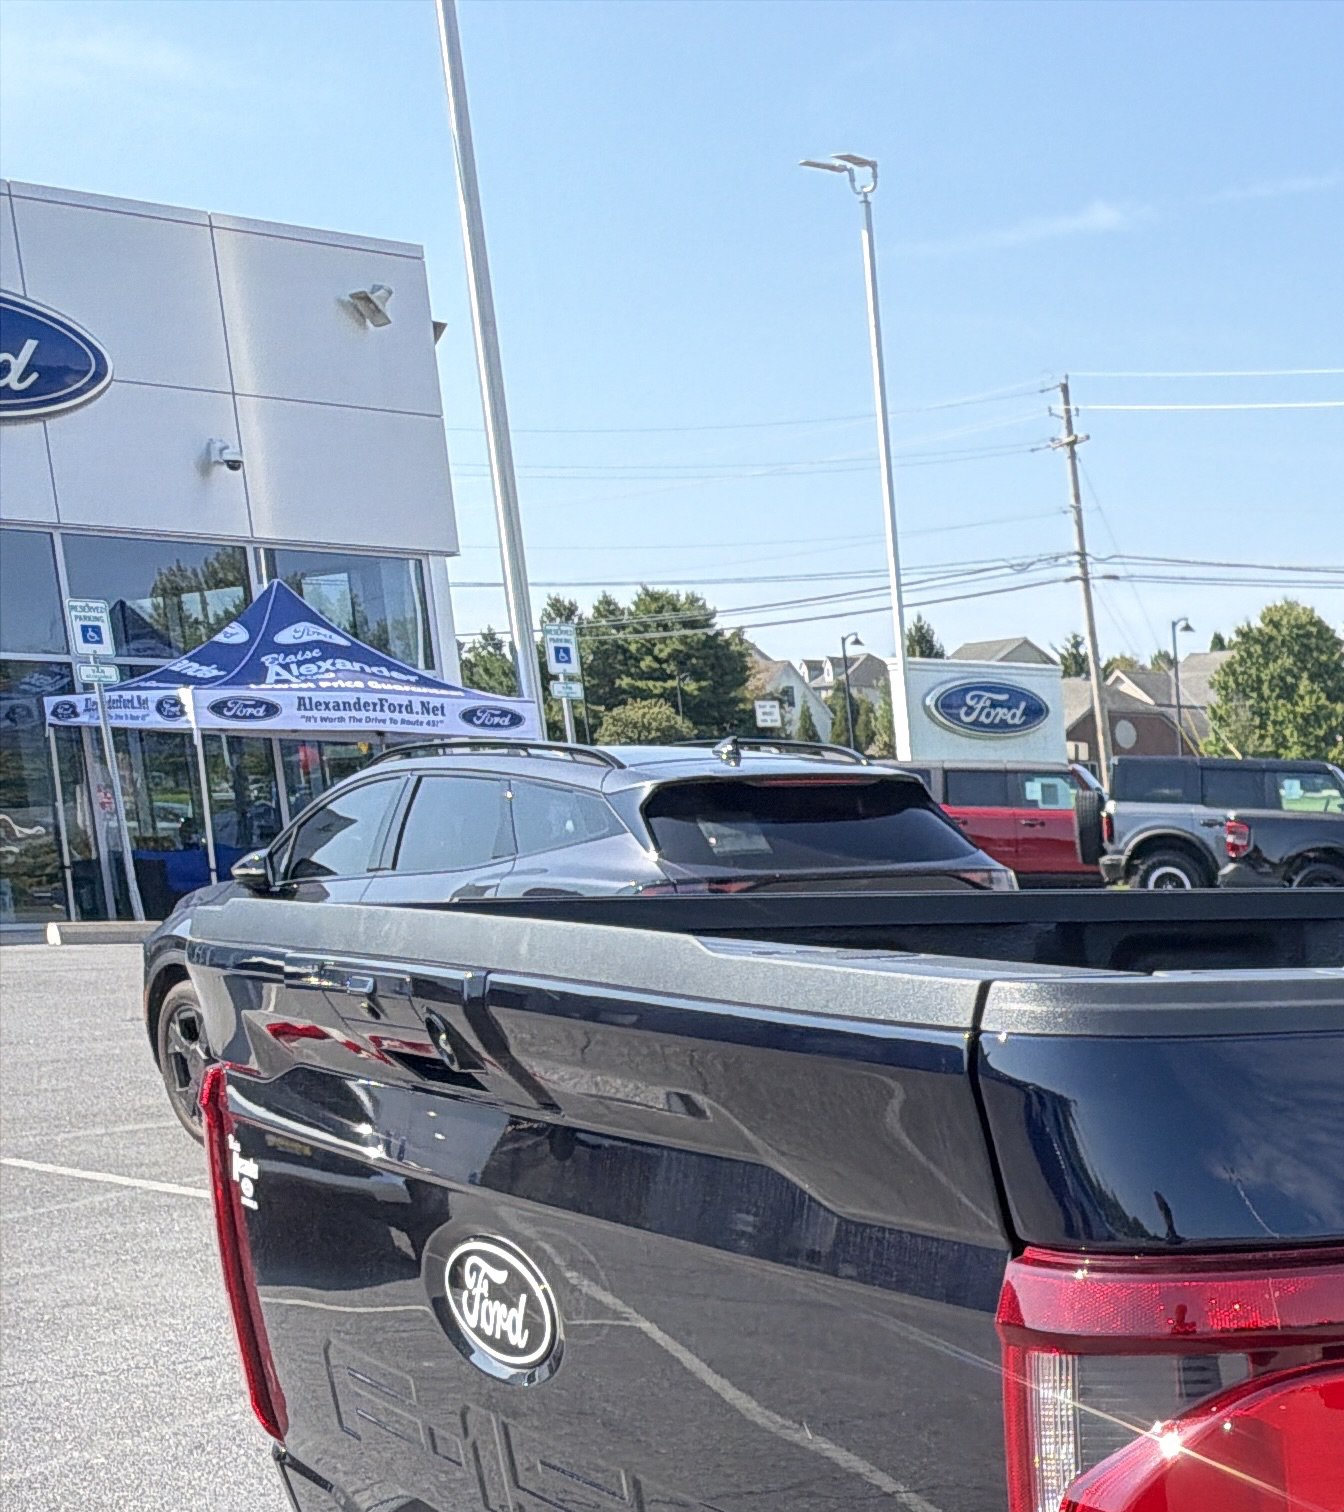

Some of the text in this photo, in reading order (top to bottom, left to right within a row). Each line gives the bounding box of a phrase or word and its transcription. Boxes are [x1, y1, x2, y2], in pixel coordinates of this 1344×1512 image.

[74, 614, 105, 622] PARKING
[265, 658, 419, 684] Alexander
[223, 699, 266, 718] Ford
[296, 695, 447, 717] AlexanderFord.Net
[959, 690, 1026, 725] Ford
[319, 715, 346, 724] Worth
[348, 715, 363, 724] The
[364, 715, 387, 725] Drive
[389, 716, 399, 725] To
[400, 717, 424, 726] Route
[472, 707, 512, 726] Ford
[461, 1255, 529, 1349] Ford
